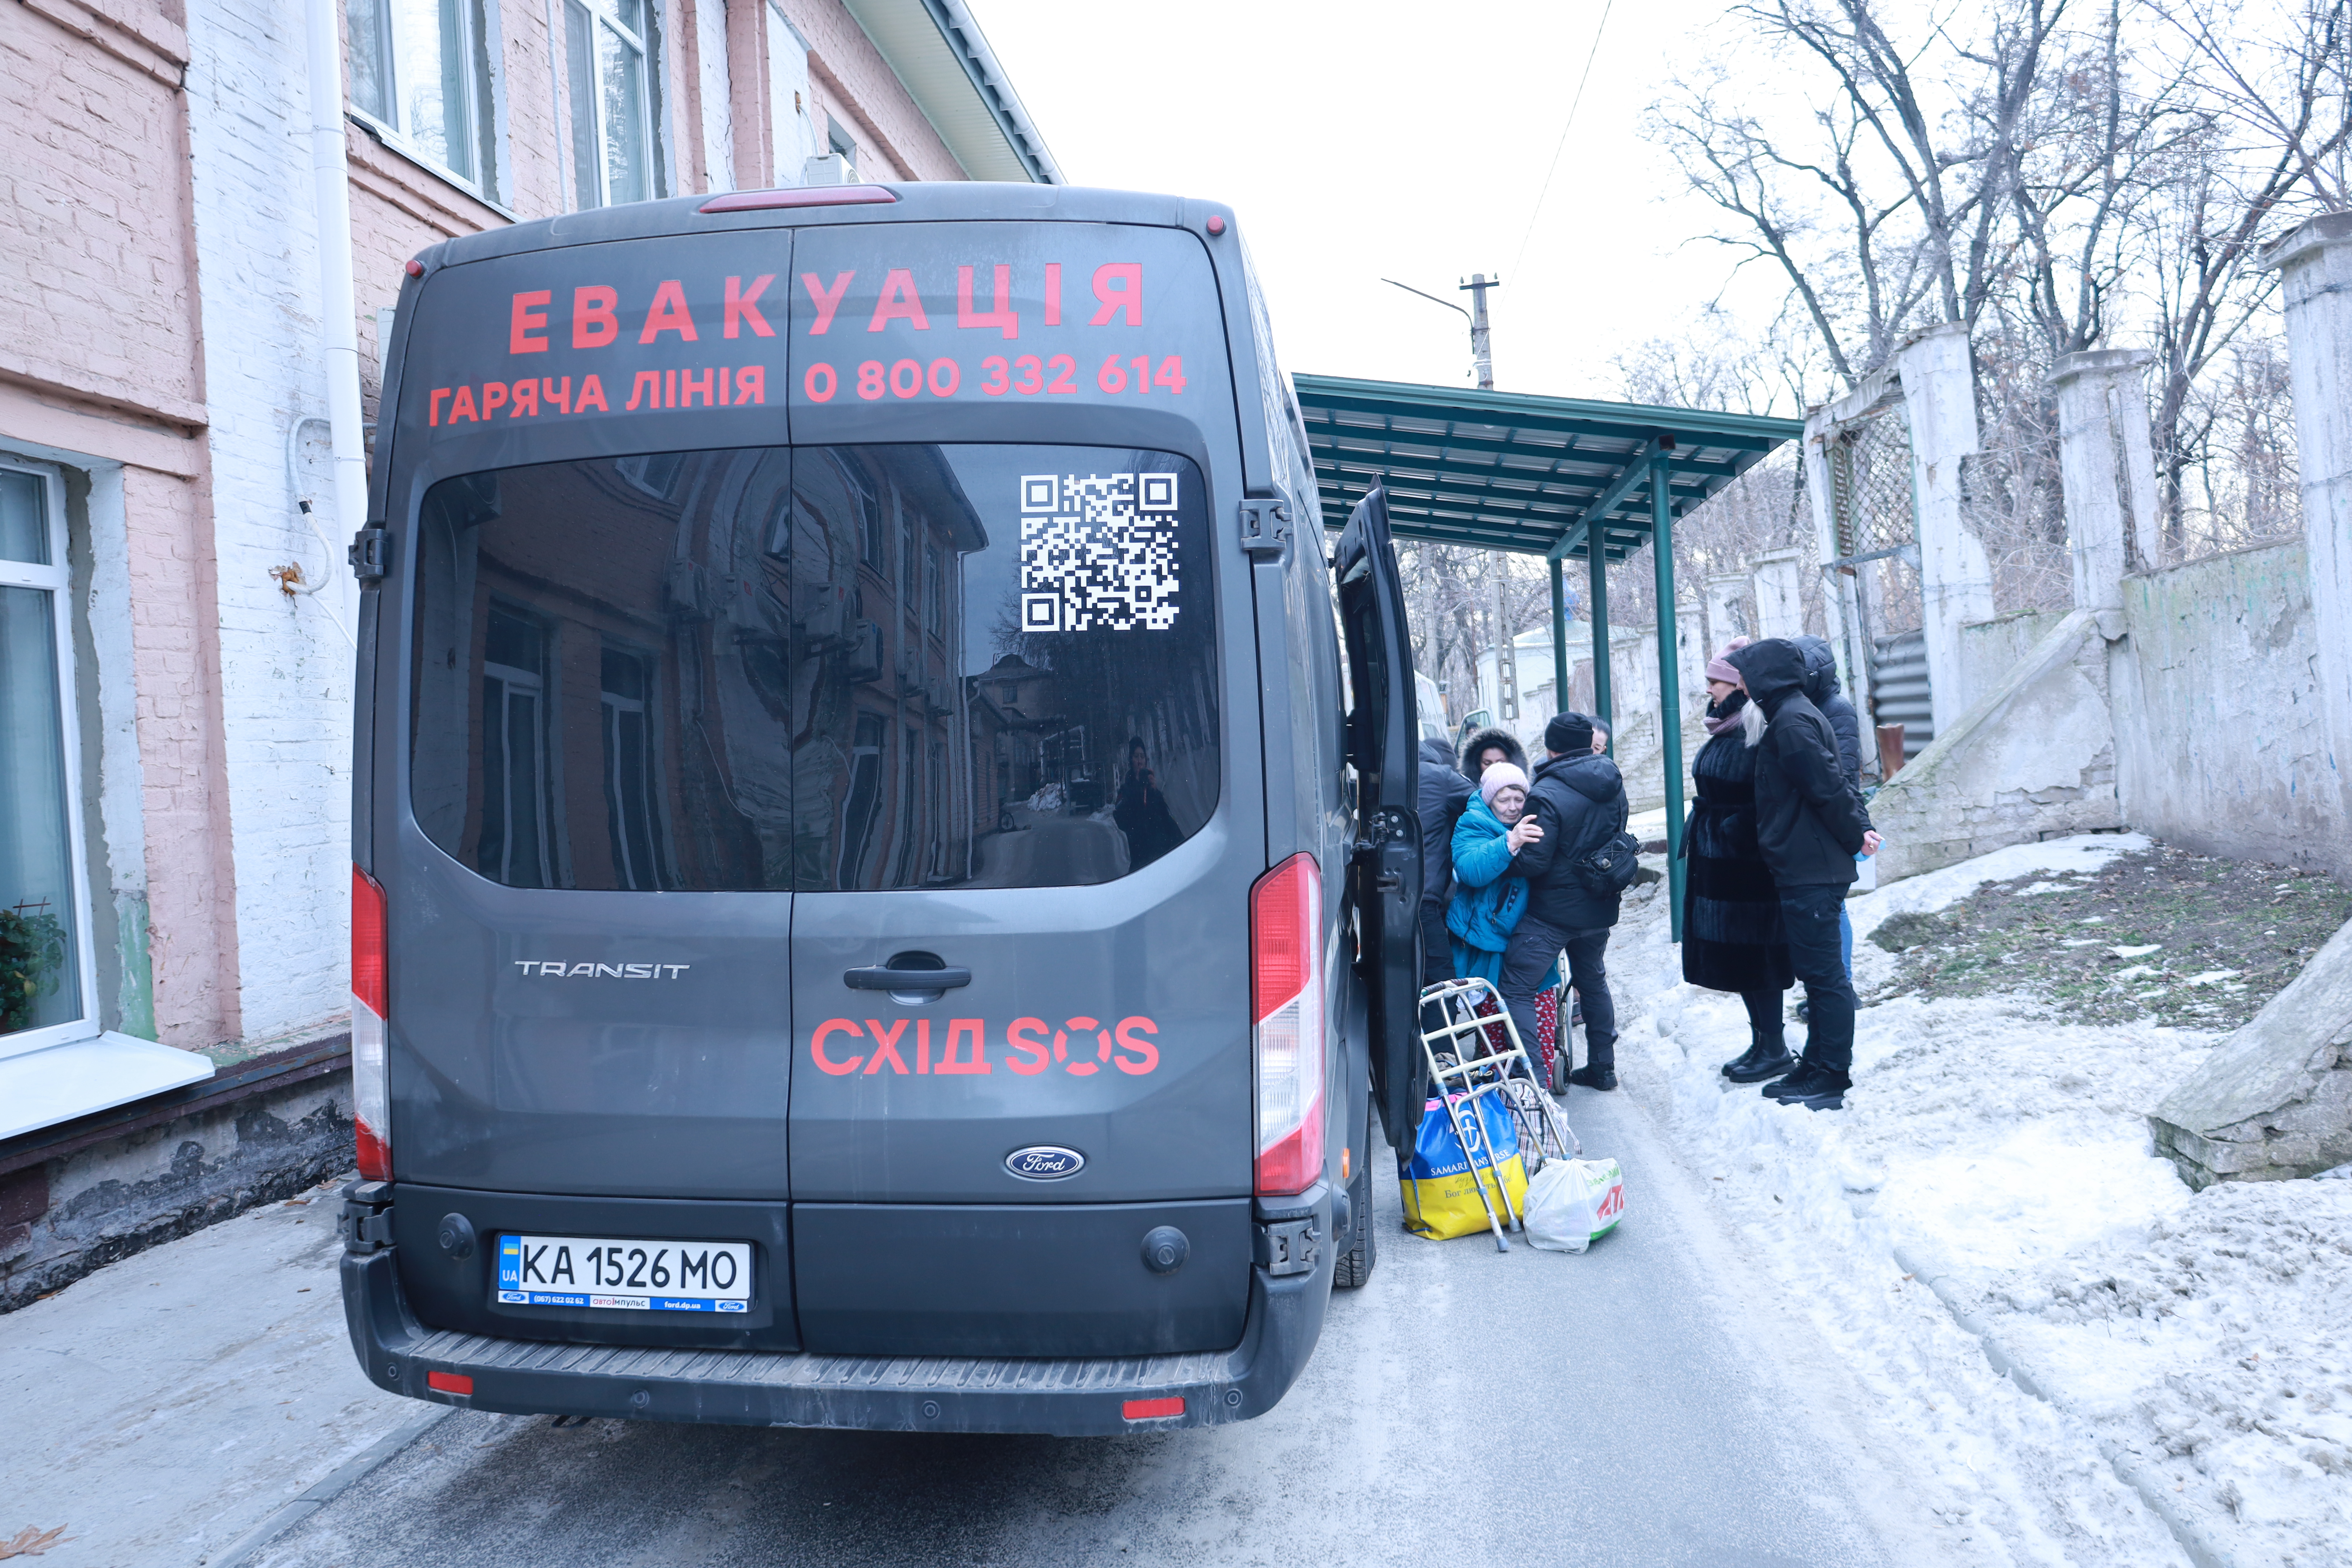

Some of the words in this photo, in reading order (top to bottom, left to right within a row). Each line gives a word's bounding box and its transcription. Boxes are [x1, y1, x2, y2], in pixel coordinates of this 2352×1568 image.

[510, 263, 1142, 355] ЕВАКУАЦІЯ
[429, 374, 609, 427] ГАРЯЧА
[626, 366, 765, 411] ЛІНІЯ
[805, 363, 837, 403] 0
[857, 357, 960, 400] 800
[981, 354, 1077, 396] 332
[1098, 354, 1187, 394] 614
[514, 961, 691, 979] TRANSIT
[811, 1018, 992, 1076] СХІД
[1005, 1016, 1159, 1076] SOS
[1022, 1153, 1066, 1171] Ford
[1430, 1156, 1488, 1176] SAMARIAN'S
[1490, 1149, 1510, 1162] RSE
[1444, 1189, 1461, 1198] Бог
[1464, 1183, 1496, 1195] лють
[1503, 1173, 1512, 1184] бе!
[502, 1269, 518, 1282] UA
[586, 1247, 670, 1288] 1526
[534, 1295, 551, 1303] (067)
[664, 1301, 701, 1310] ford.dp.ua
